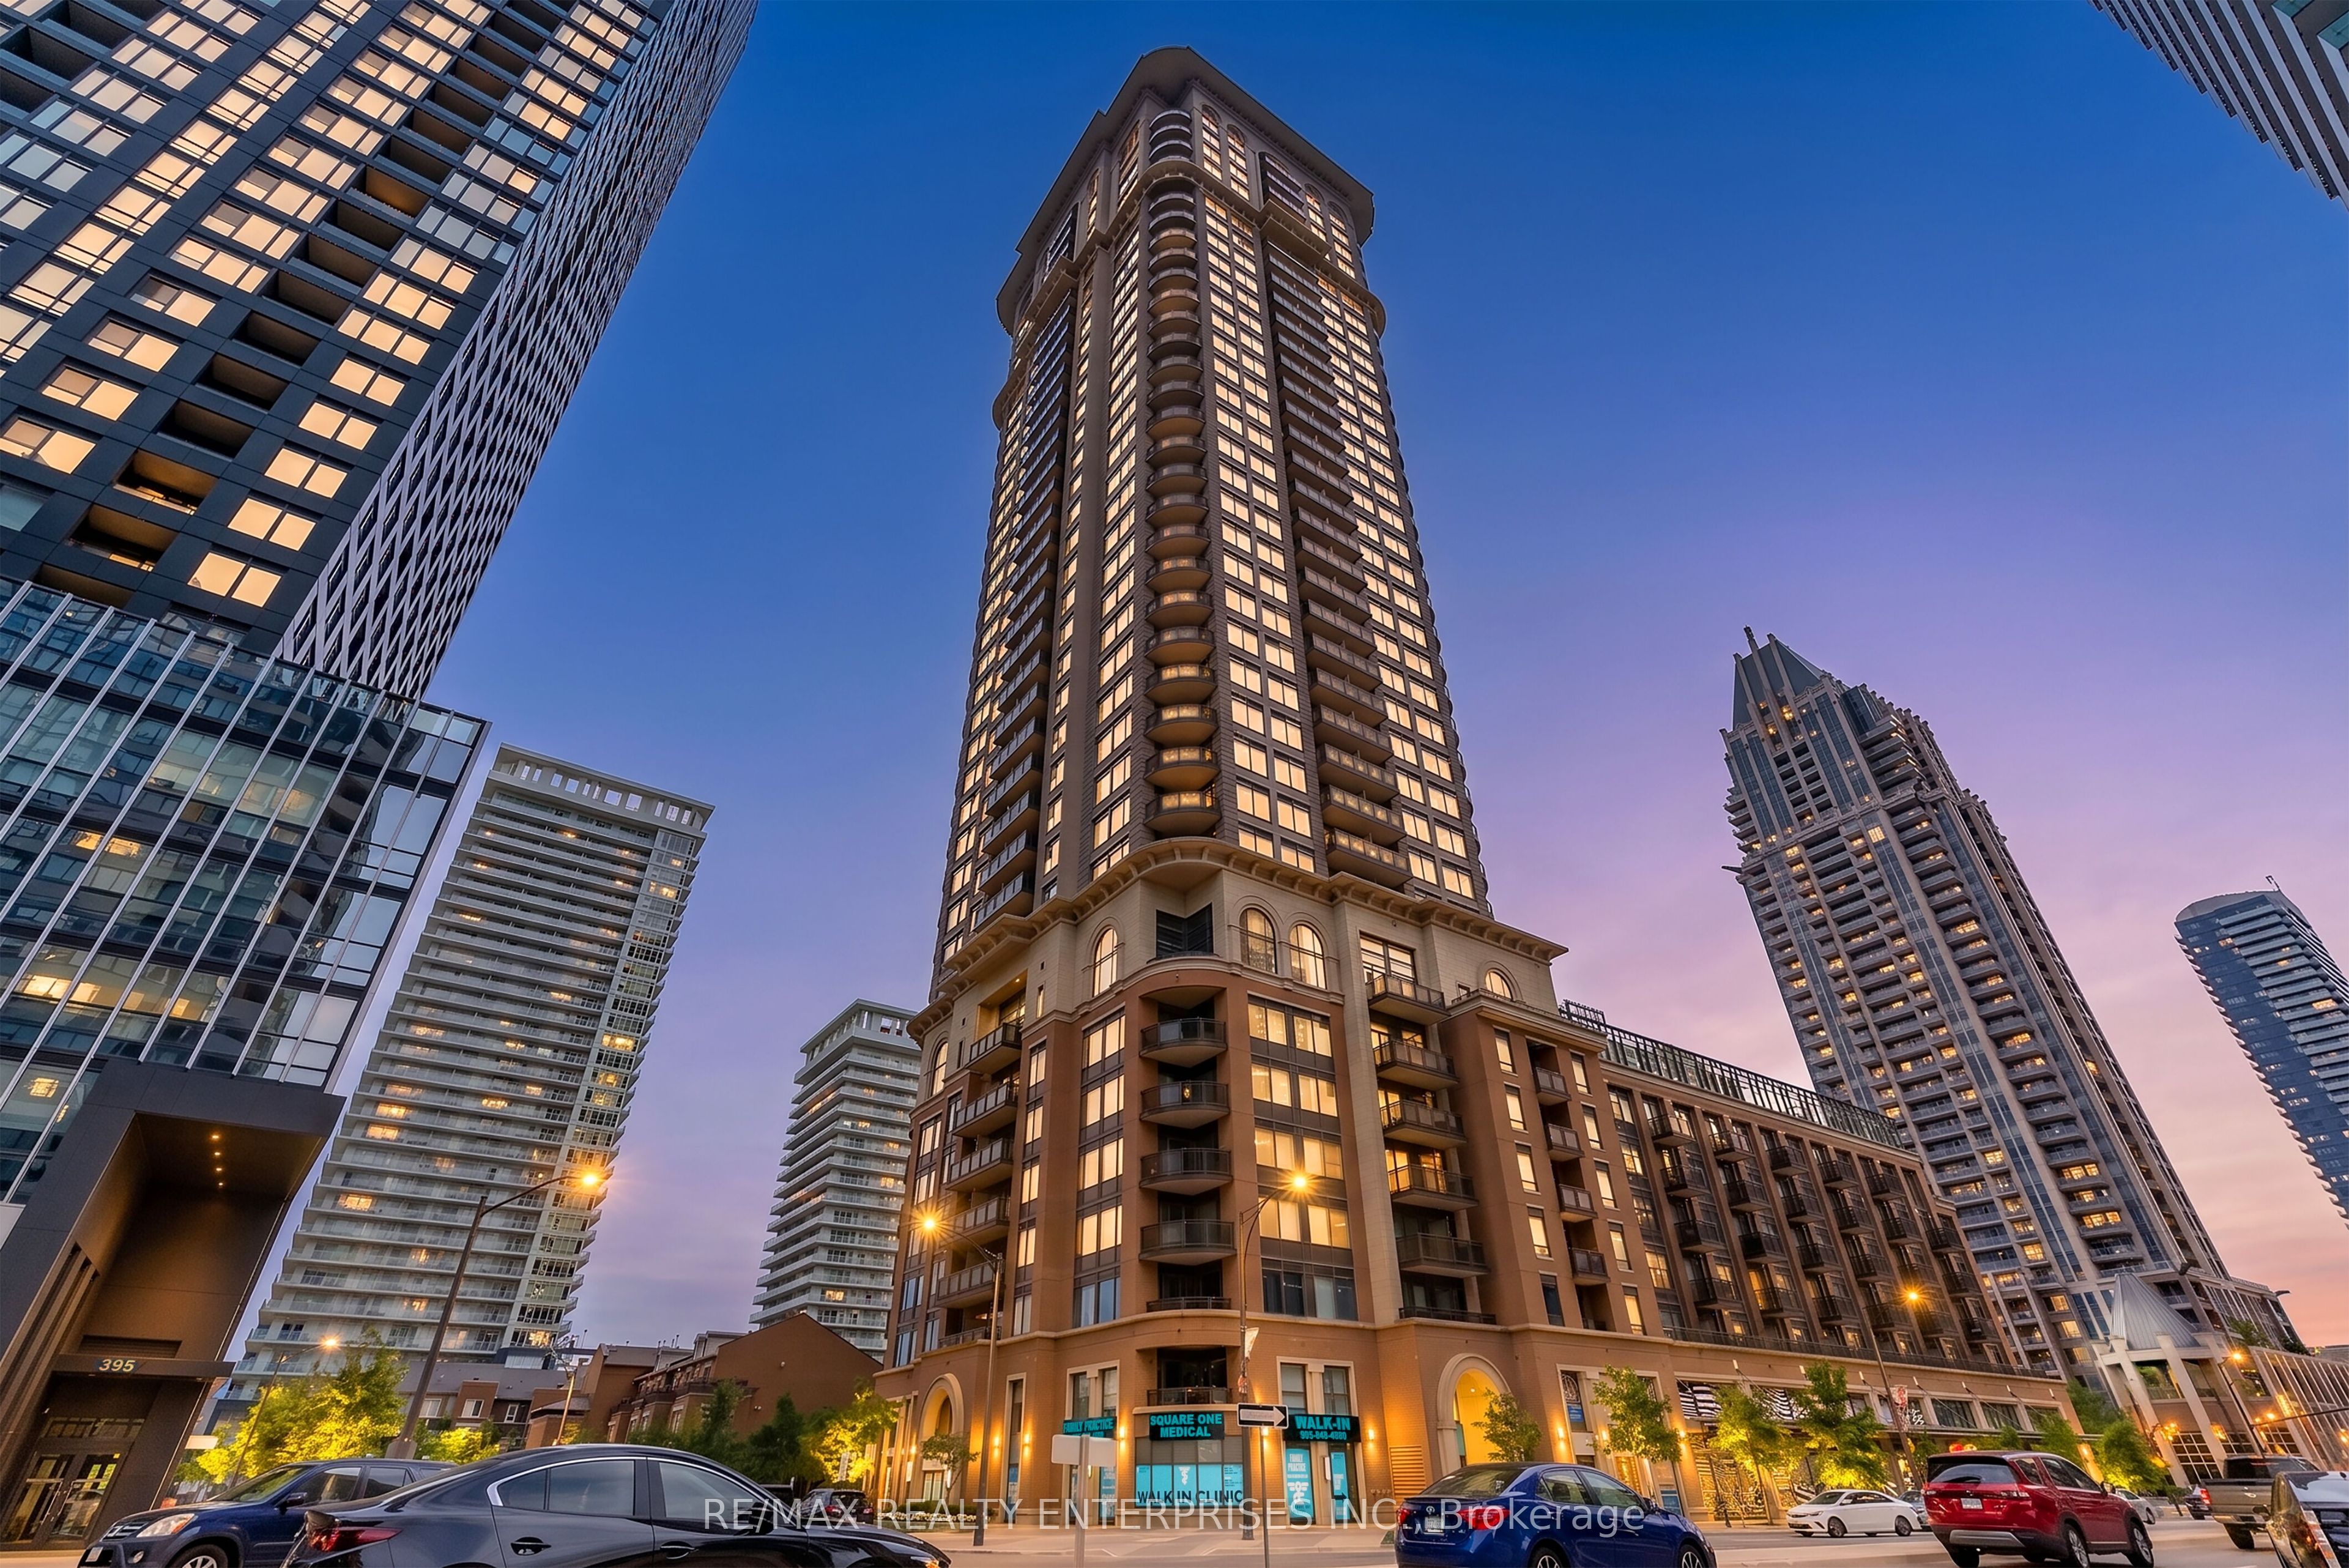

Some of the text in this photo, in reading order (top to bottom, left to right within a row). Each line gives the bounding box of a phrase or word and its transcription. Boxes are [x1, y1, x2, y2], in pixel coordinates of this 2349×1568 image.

[98, 1359, 136, 1372] 395
[1063, 1418, 1114, 1433] FAMILY PRACTICE
[1150, 1414, 1222, 1426] SQUARE ONE
[1294, 1416, 1351, 1430] WALK-IN
[1160, 1426, 1211, 1438] MEDICAL
[1137, 1490, 1243, 1504] WALK IN CLINIC
